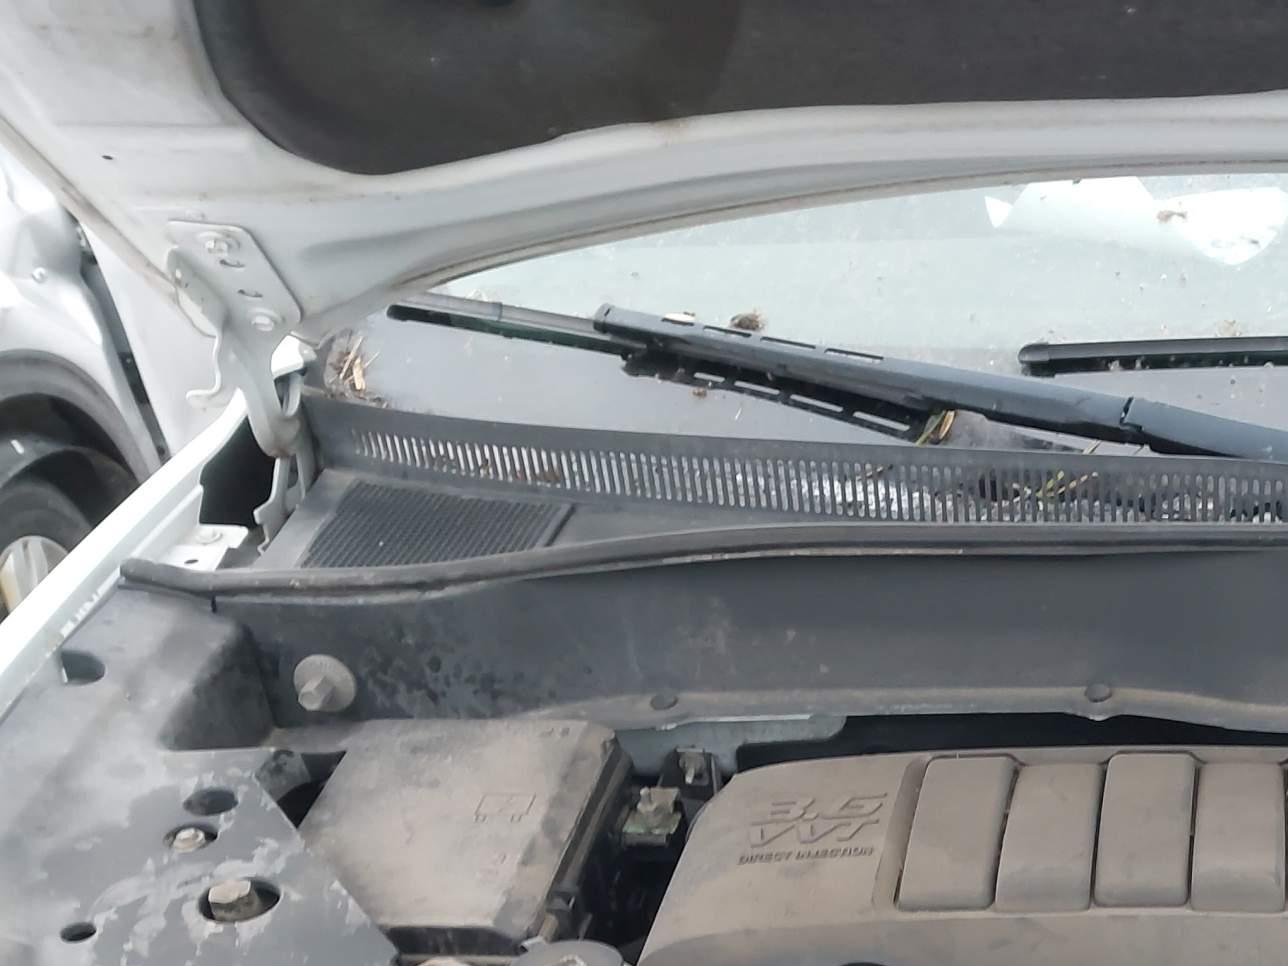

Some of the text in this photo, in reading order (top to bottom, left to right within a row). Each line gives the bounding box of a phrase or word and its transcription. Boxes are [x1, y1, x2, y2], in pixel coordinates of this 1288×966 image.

[750, 792, 888, 826] 3.6
[749, 819, 881, 849] VVT
[737, 850, 793, 865] DIRECT
